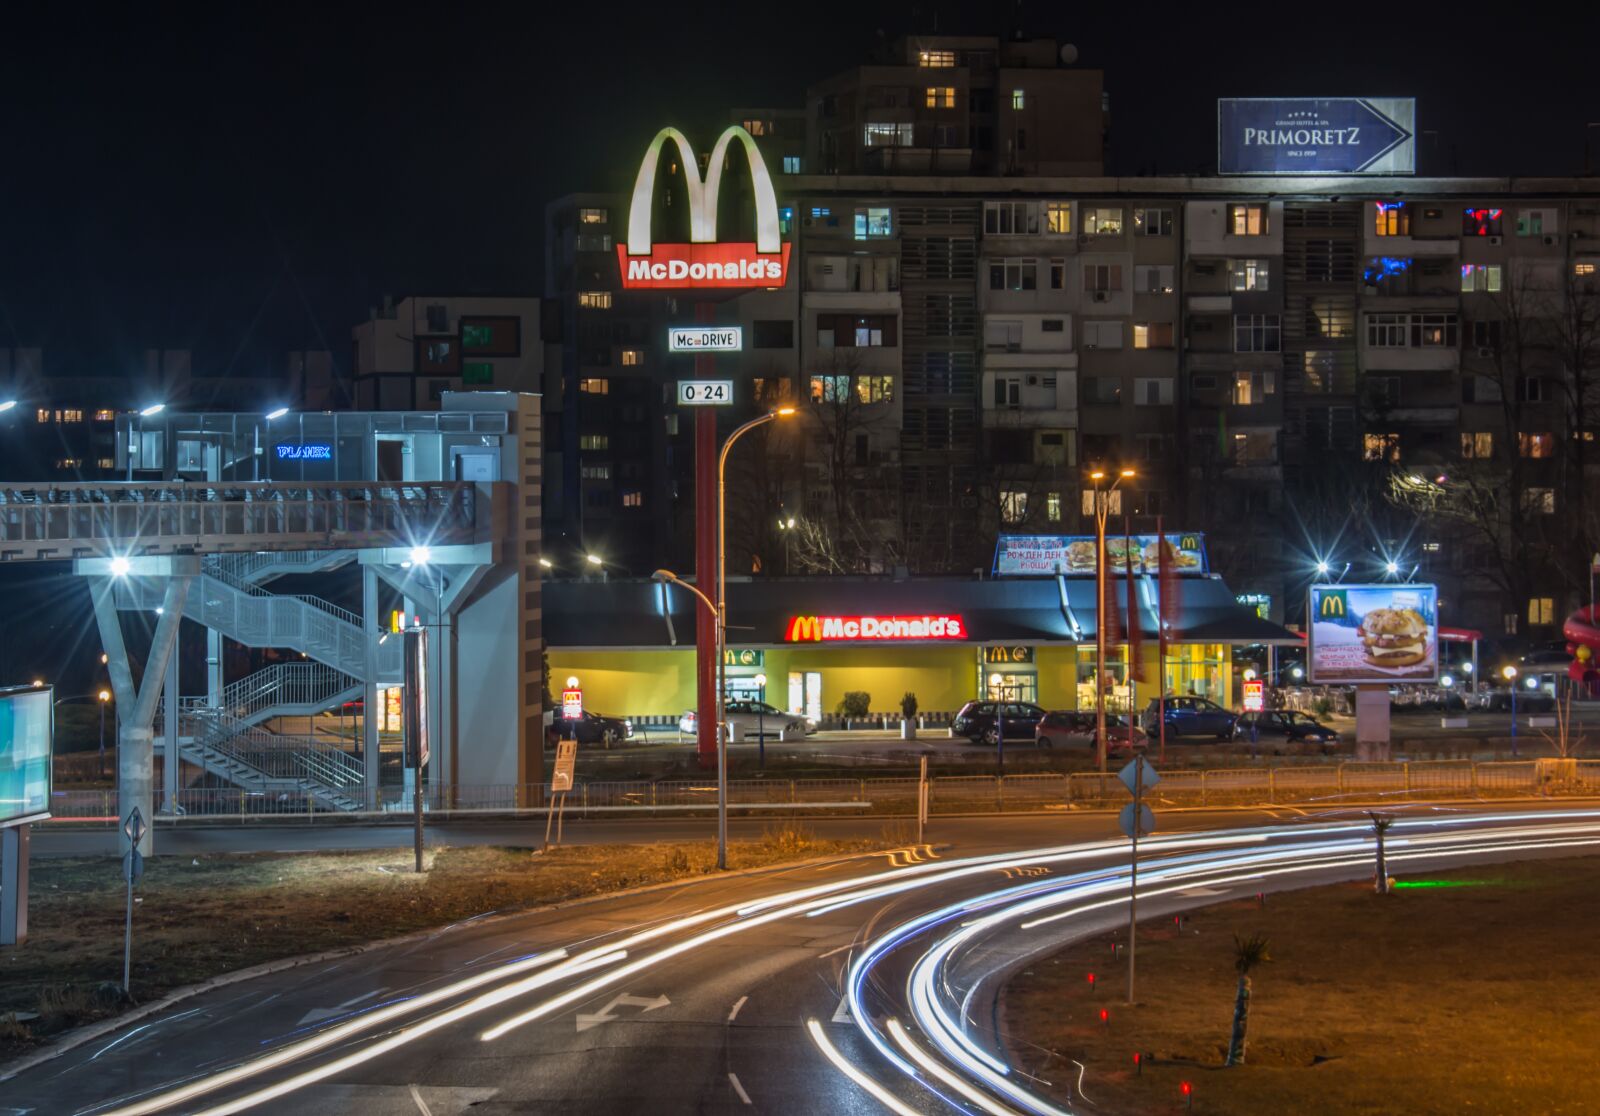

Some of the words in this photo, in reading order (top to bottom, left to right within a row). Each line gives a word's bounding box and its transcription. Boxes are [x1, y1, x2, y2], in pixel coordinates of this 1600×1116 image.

[1244, 127, 1360, 145] PRIMORETZ
[628, 259, 782, 280] McDonald's
[1007, 551, 1042, 560] РОЖДЕН
[822, 616, 961, 638] McDonald's
